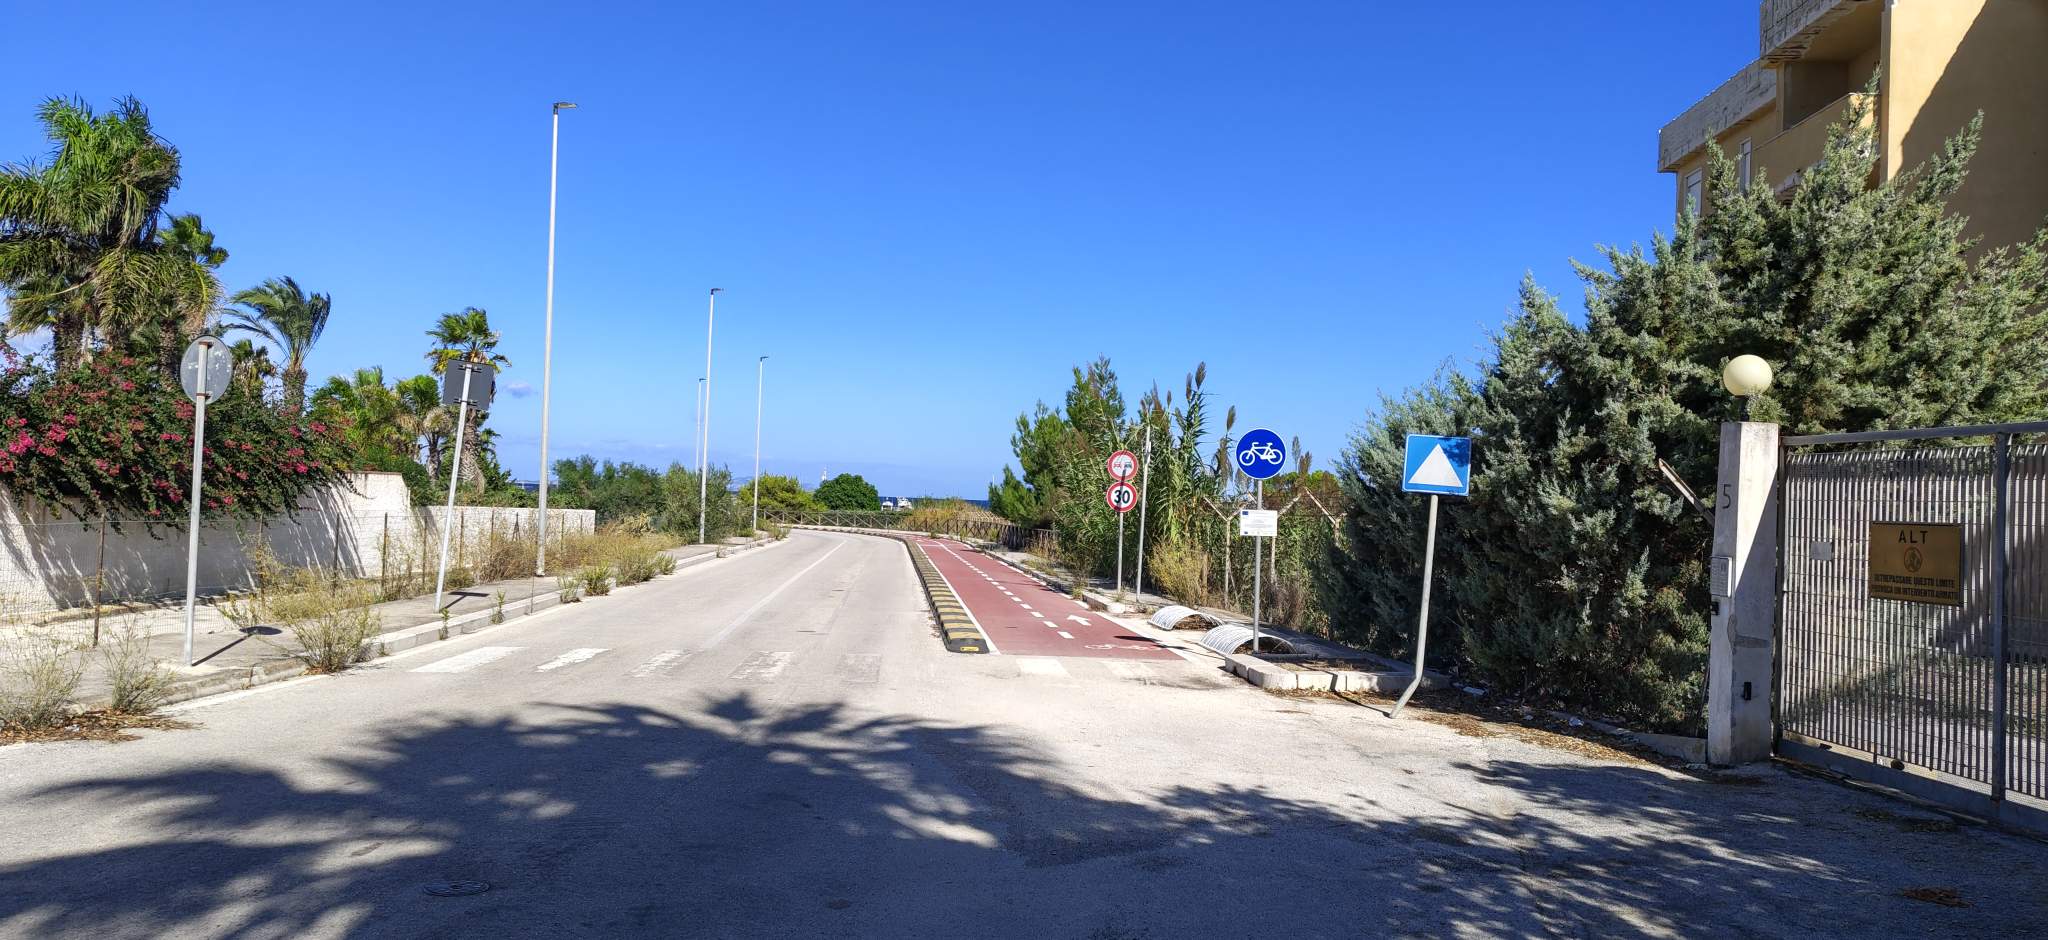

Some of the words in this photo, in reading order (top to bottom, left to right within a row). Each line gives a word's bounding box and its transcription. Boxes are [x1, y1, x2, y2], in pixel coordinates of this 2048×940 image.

[1114, 489, 1130, 504] 30
[1722, 484, 1732, 509] 5
[1898, 530, 1928, 544] ALT
